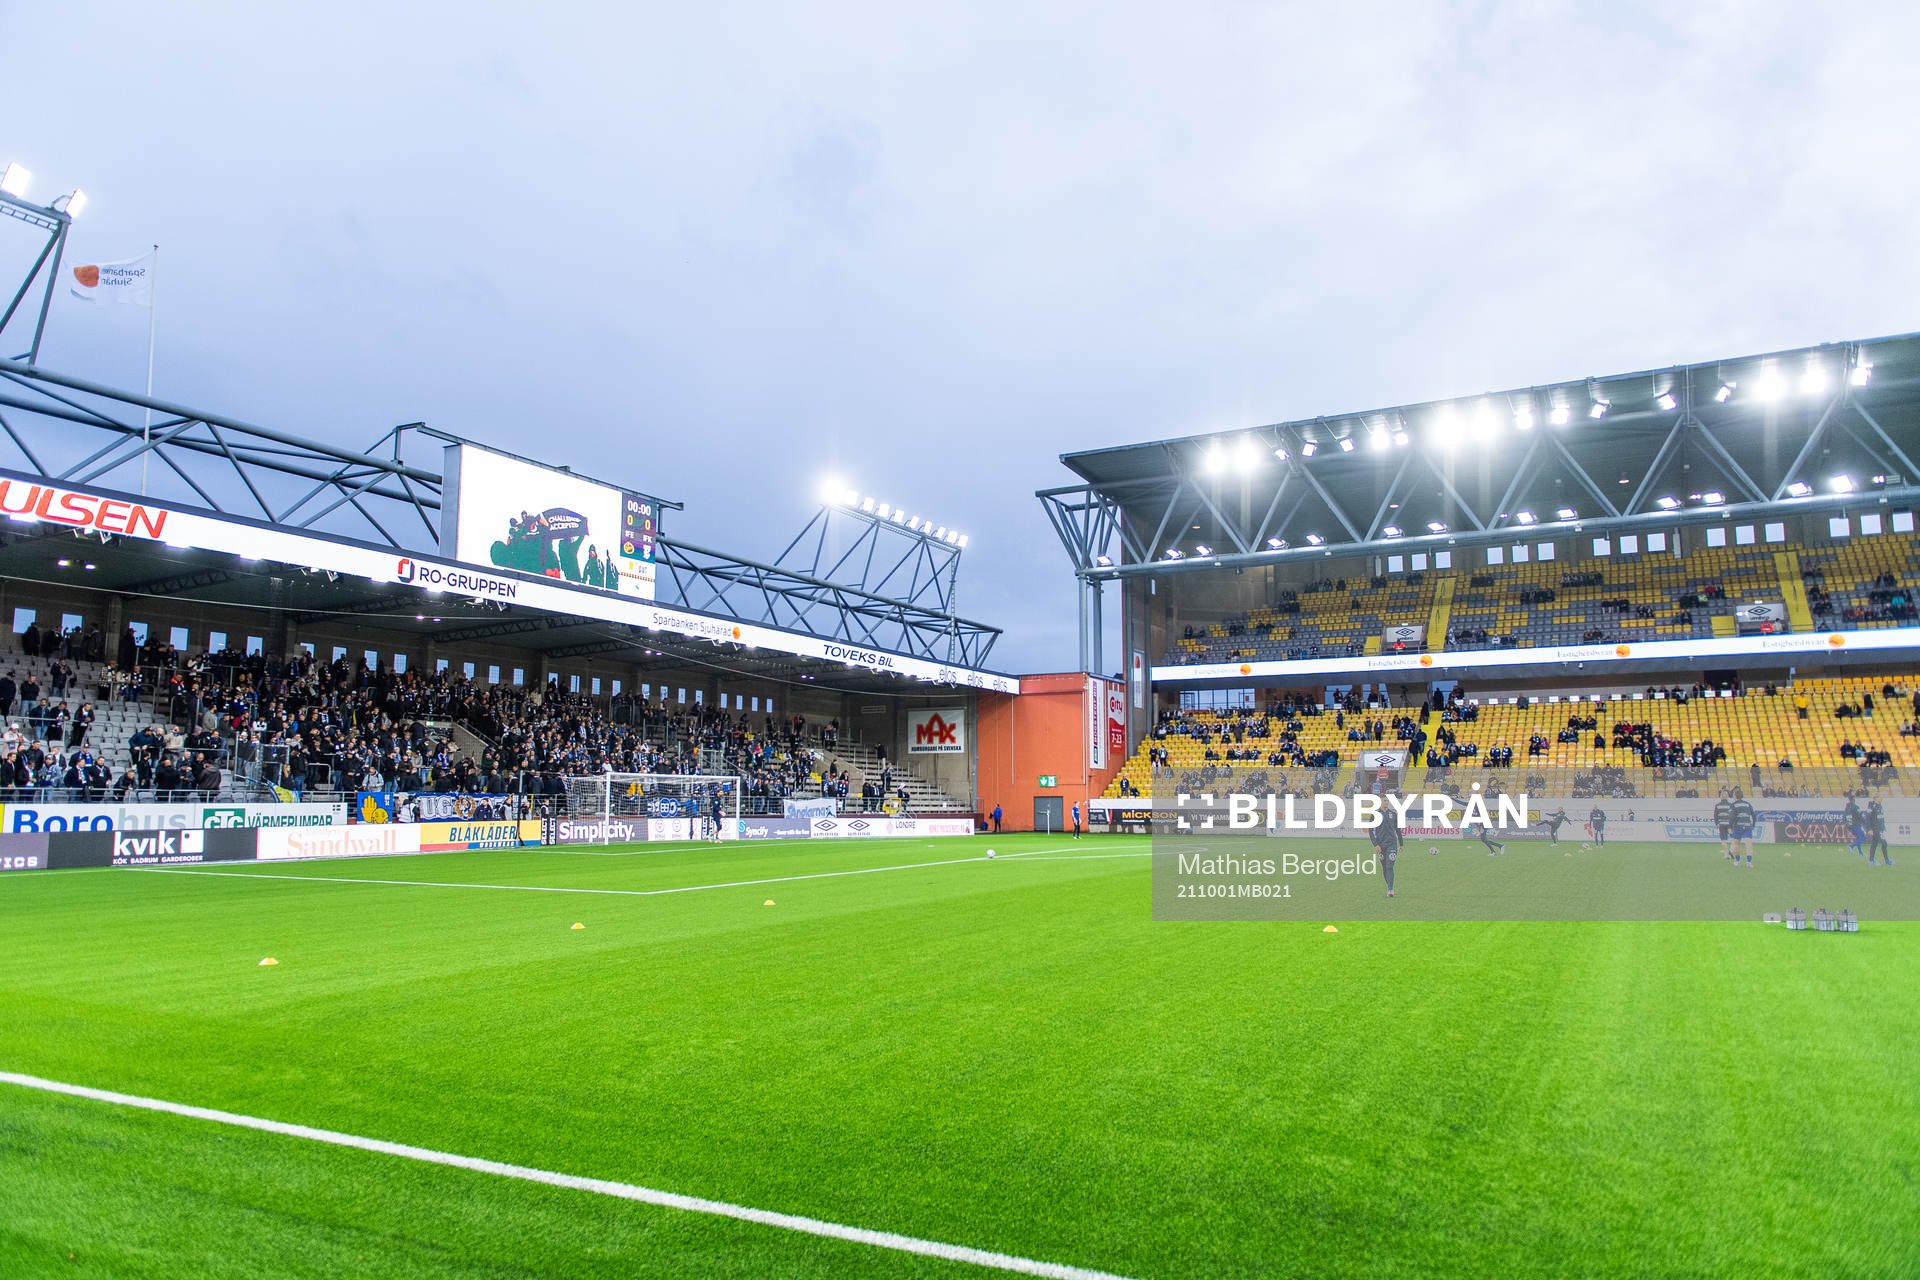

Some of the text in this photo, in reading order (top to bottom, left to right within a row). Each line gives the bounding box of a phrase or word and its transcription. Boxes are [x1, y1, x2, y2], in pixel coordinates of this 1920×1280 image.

[627, 500, 652, 516] 00:00
[627, 514, 651, 531] 0 0
[419, 566, 517, 598] RO-GRUPPEN
[652, 612, 700, 631] Sparbanken
[823, 644, 894, 668] TOVEKS BIL
[916, 711, 957, 745] MAX
[13, 808, 187, 833] Borohus
[449, 822, 517, 842] BLÅKLÄDER
[113, 830, 176, 857] kvik
[287, 829, 396, 856] Sandwall
[0, 856, 38, 868] ICS
